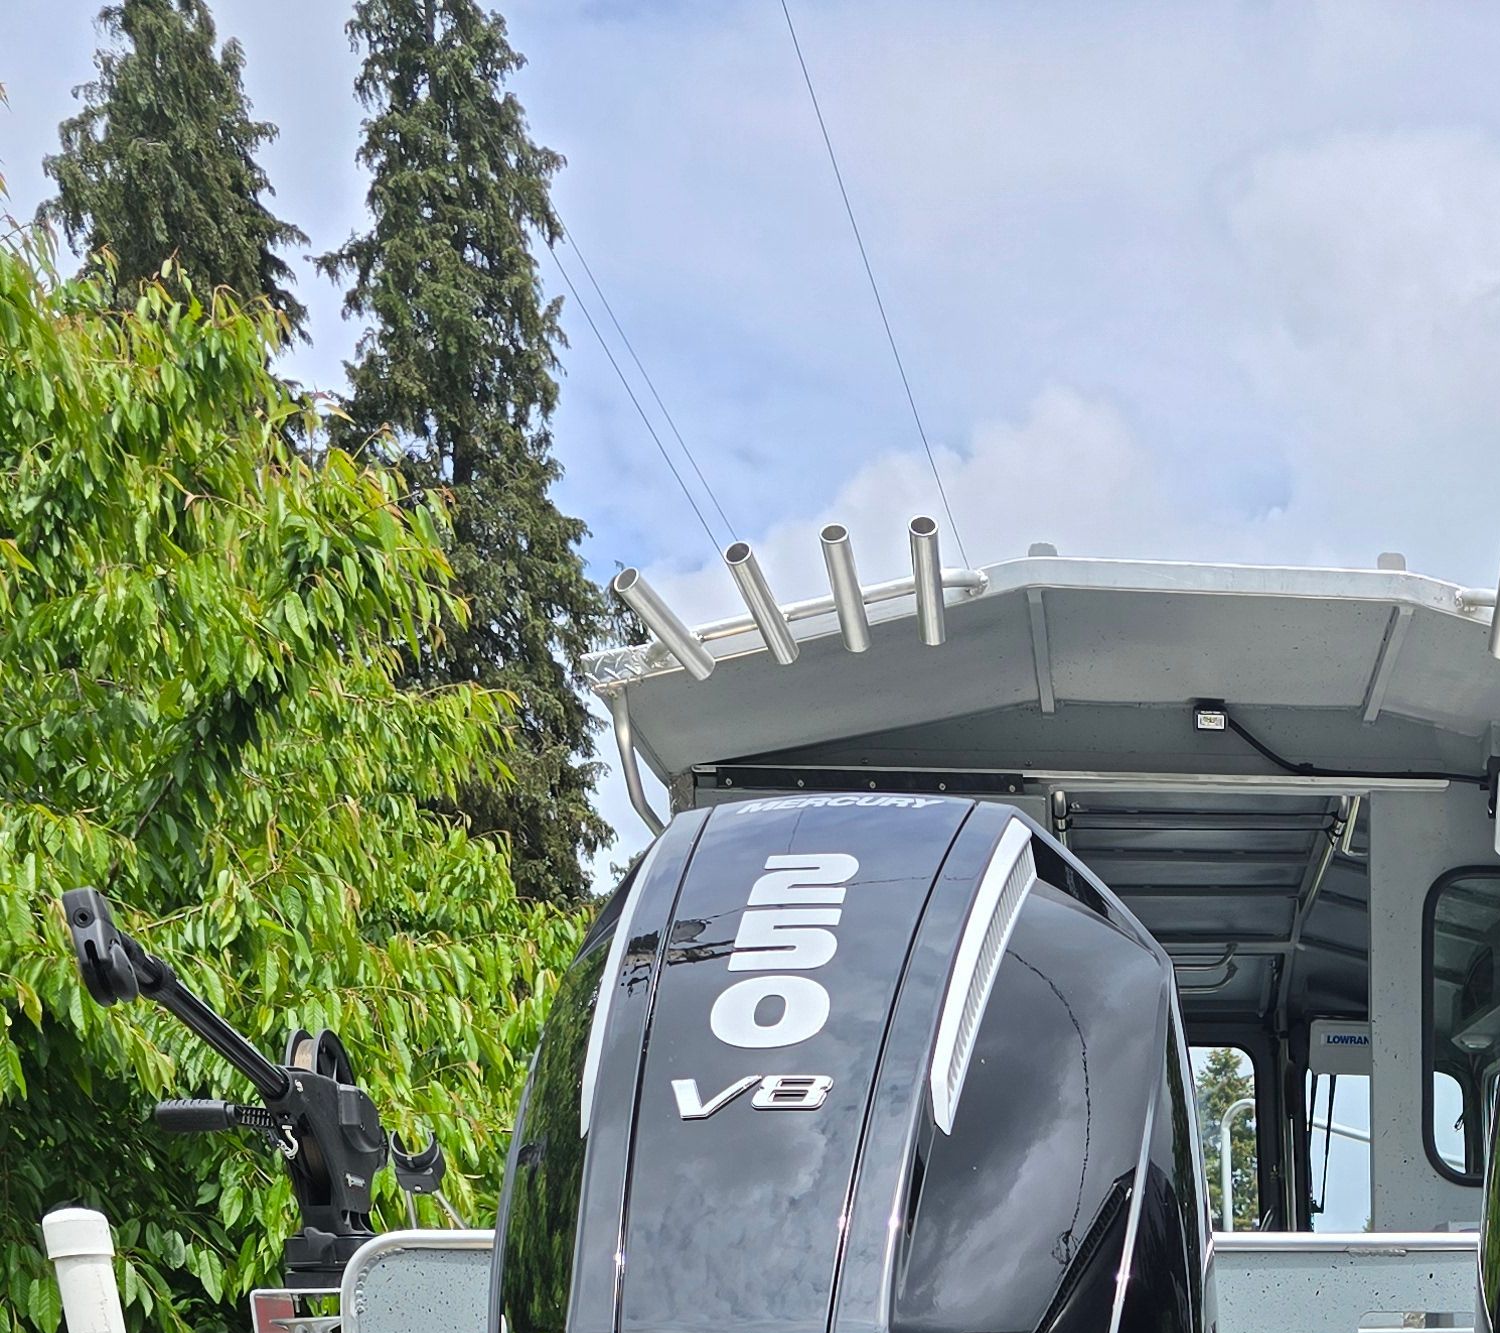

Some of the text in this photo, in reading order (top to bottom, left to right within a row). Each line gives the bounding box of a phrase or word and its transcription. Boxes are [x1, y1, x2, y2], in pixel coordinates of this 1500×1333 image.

[737, 796, 945, 815] MERCURY
[711, 853, 859, 1048] 250
[671, 1074, 834, 1120] V8
